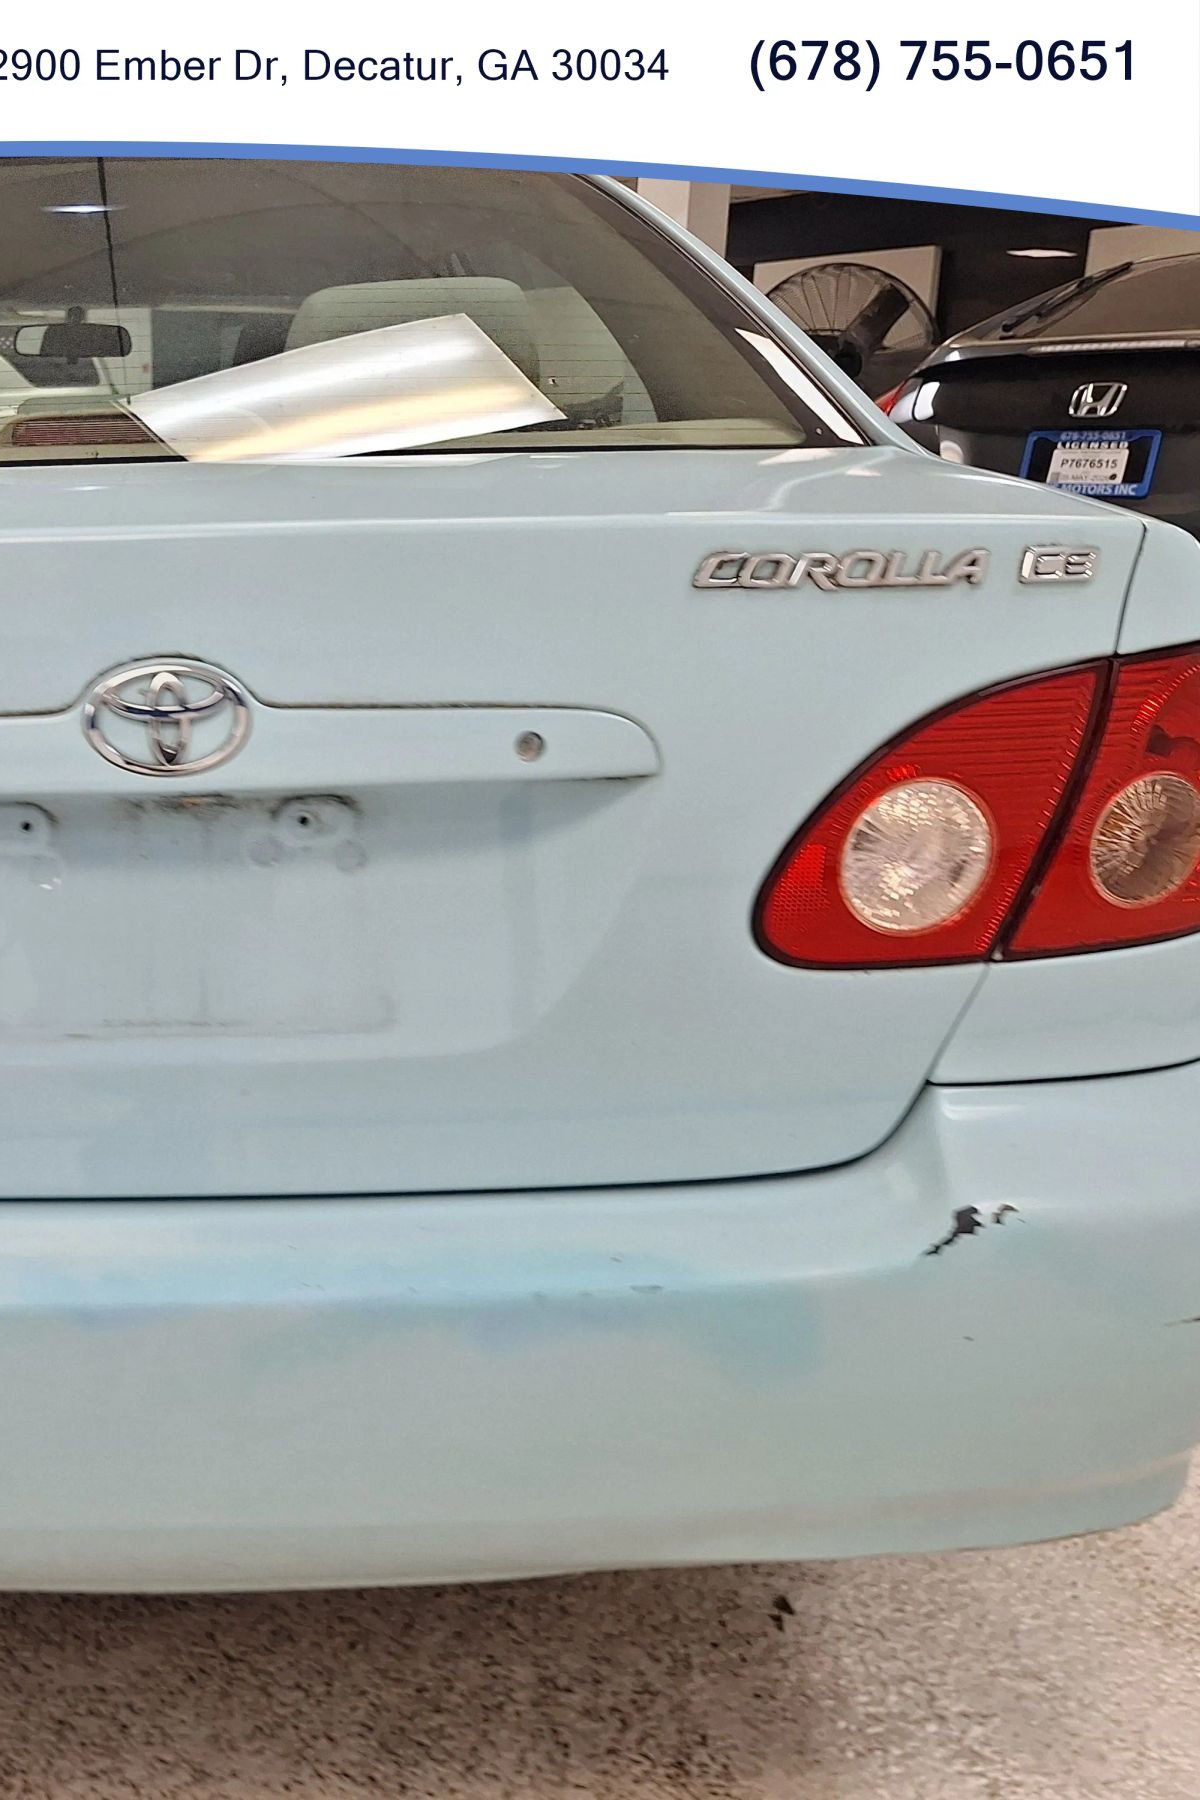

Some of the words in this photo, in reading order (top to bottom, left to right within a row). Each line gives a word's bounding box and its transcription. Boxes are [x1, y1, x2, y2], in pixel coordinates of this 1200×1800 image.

[1060, 458, 1118, 469] P7676515
[1060, 483, 1113, 495] MOTORS
[1114, 484, 1138, 496] INC
[692, 548, 990, 590] COROLLA
[1019, 545, 1099, 583] CE
